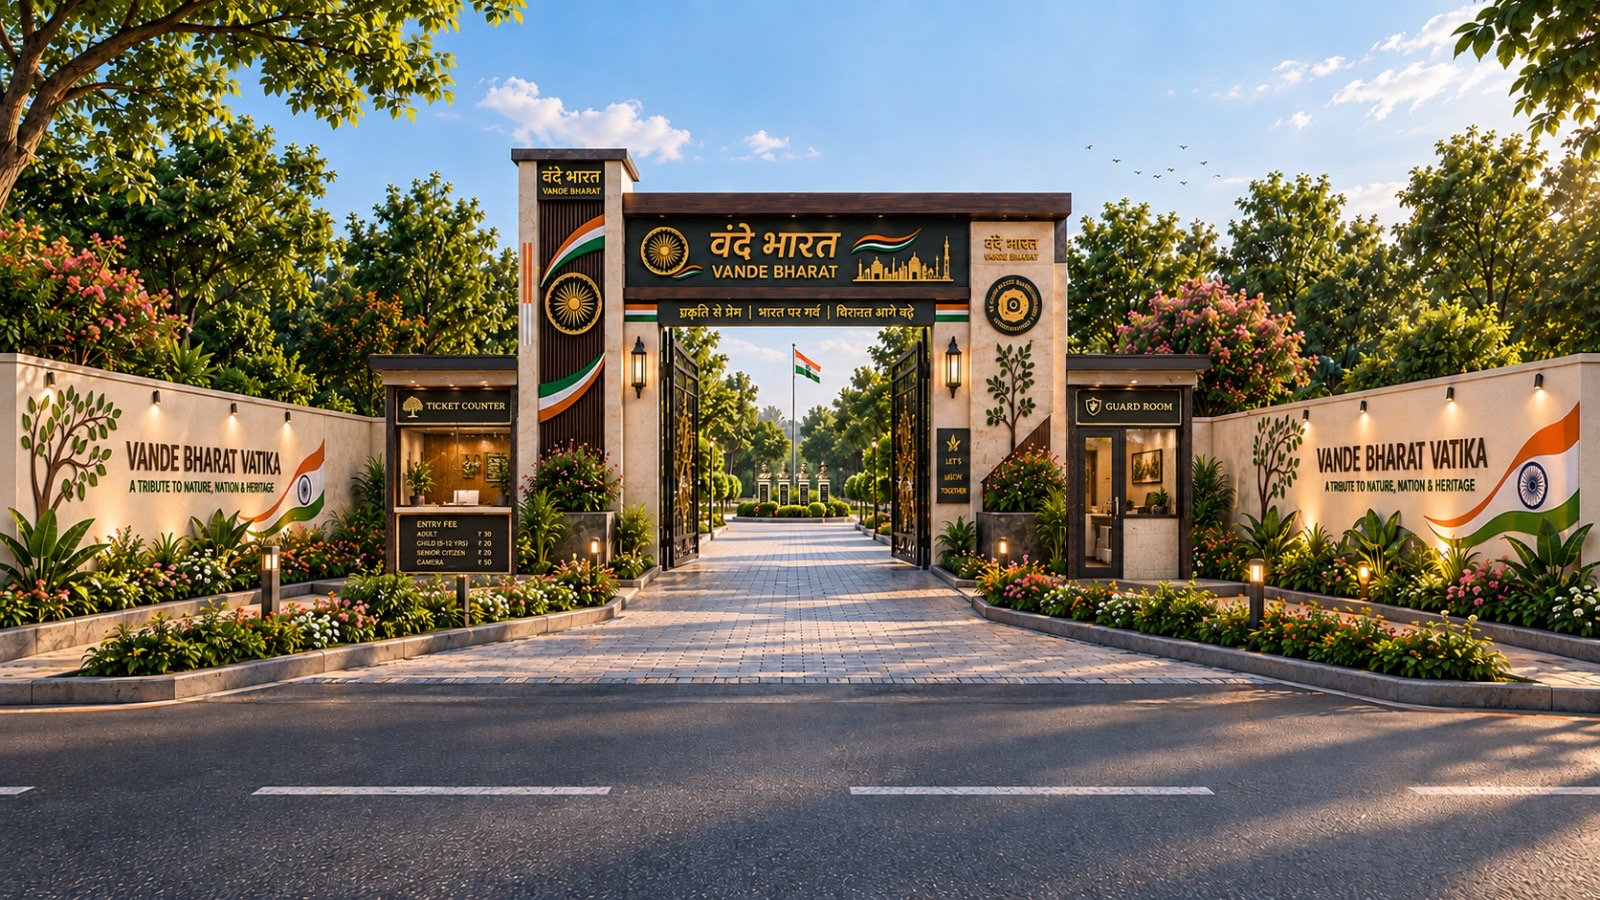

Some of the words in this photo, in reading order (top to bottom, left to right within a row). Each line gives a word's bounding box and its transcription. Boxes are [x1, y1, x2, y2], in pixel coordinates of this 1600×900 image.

[541, 165, 563, 185] वंदे
[566, 170, 602, 184] भारत
[542, 187, 569, 195] VANDE
[570, 187, 602, 195] BHARAT
[710, 222, 756, 261] वंदे
[762, 232, 842, 259] भारत
[712, 265, 769, 279] VANDE
[773, 265, 838, 279] BHARAT
[712, 303, 723, 318] से
[725, 303, 743, 318] प्रेम
[758, 307, 786, 318] भारत
[787, 307, 801, 318] पर
[875, 303, 897, 318] आगे
[426, 402, 460, 410] TICKET
[461, 402, 506, 410] COUNTER
[1105, 402, 1140, 411] GUARD
[1143, 402, 1173, 411] ROOM
[126, 441, 180, 472] VANDE
[183, 445, 238, 474] BHARAT
[241, 449, 282, 475] VATIKA
[1317, 446, 1361, 473] VANDE
[1365, 441, 1426, 472] BHARAT
[1430, 437, 1488, 470] VATIKA
[129, 480, 136, 493] A
[138, 480, 170, 493] TRIBUTE
[172, 480, 183, 493] TO
[184, 481, 213, 494] NATURE,
[214, 482, 239, 493] NATION
[240, 482, 245, 493] &
[246, 482, 274, 493] HERITAGE
[1356, 481, 1366, 492] TO
[1367, 480, 1396, 494] NATURE,
[1398, 479, 1426, 492] NATION
[1427, 480, 1432, 492] &
[1435, 479, 1476, 492] HERITAGE
[416, 520, 441, 528] ENTRY
[443, 520, 458, 528] FEE
